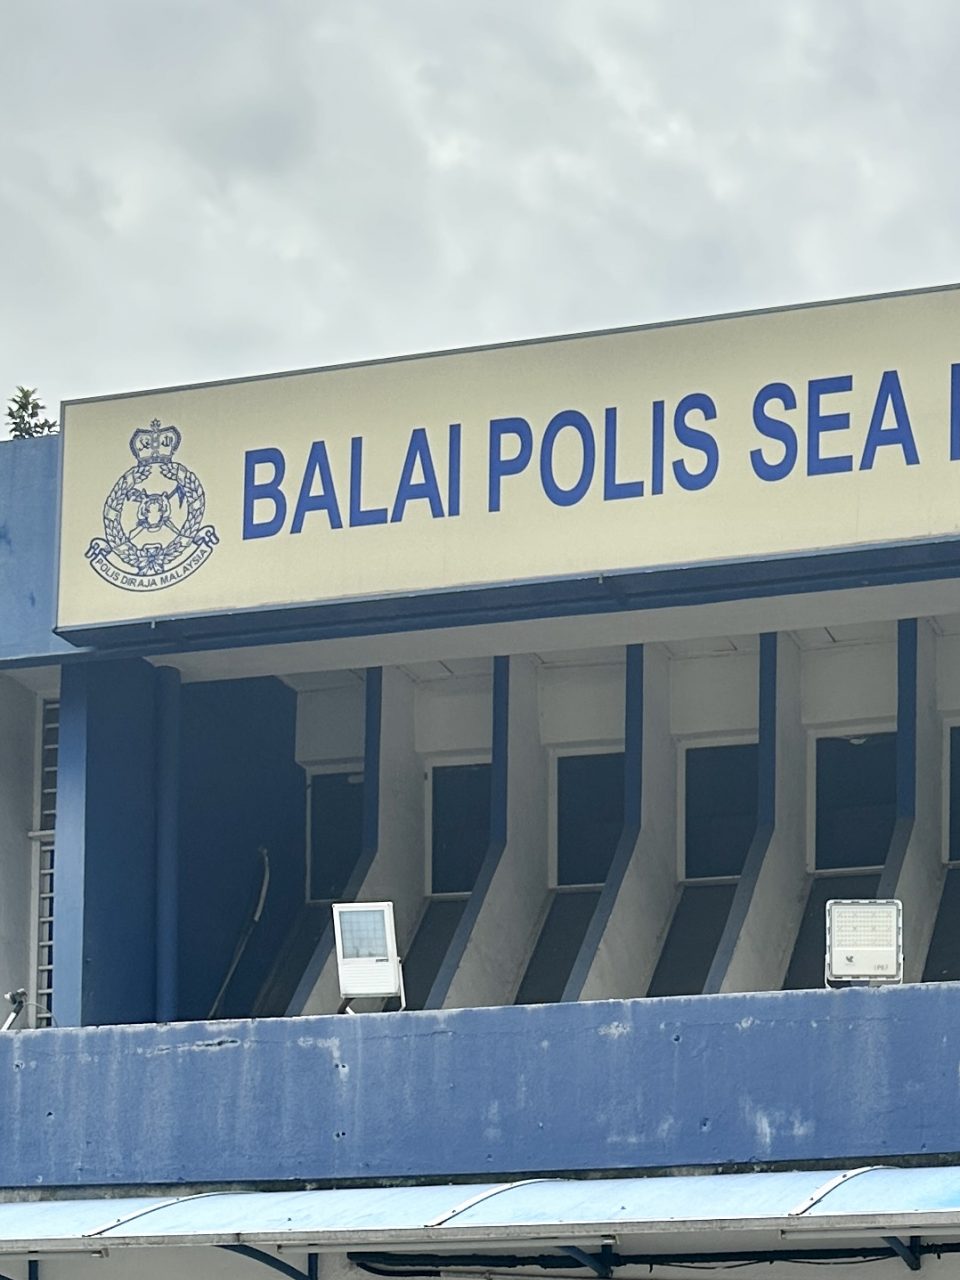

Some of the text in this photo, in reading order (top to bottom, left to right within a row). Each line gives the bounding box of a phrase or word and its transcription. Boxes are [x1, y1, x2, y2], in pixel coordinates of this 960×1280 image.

[242, 425, 461, 540] BALAI
[488, 394, 719, 512] POLIS
[750, 371, 919, 482] SEA
[94, 548, 208, 588] POLIS DIRAJA MALAYSIA
